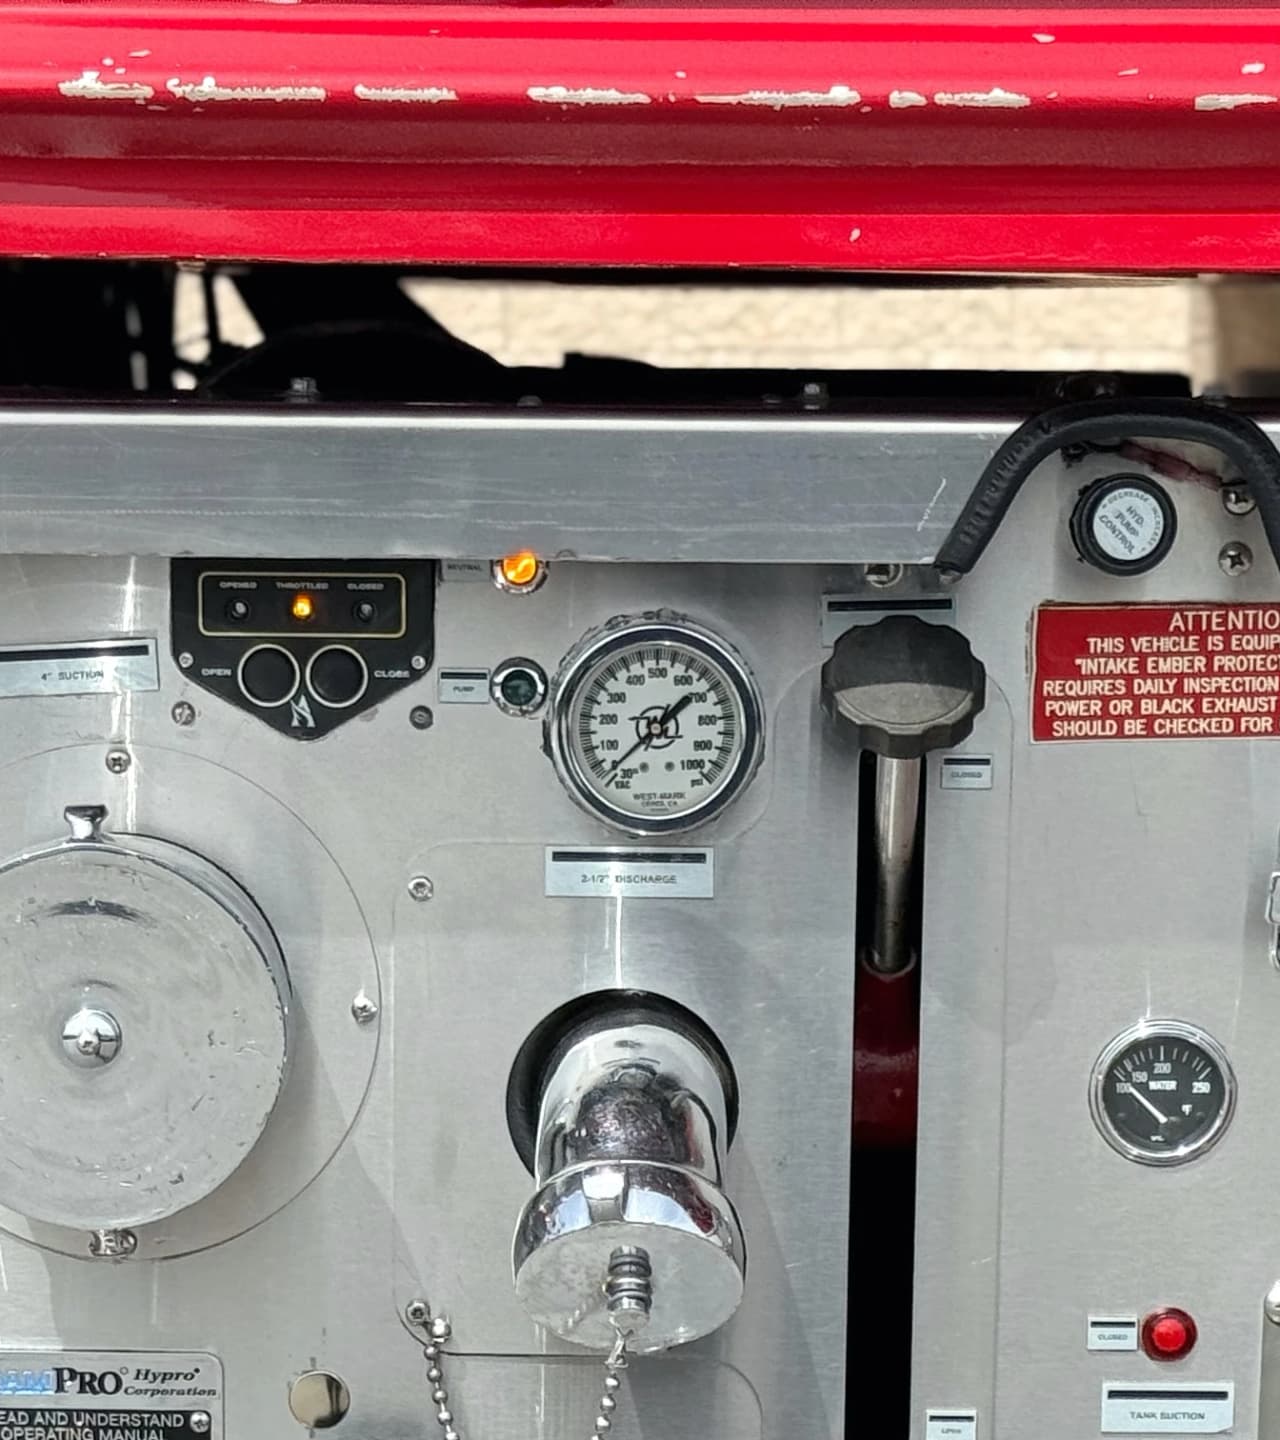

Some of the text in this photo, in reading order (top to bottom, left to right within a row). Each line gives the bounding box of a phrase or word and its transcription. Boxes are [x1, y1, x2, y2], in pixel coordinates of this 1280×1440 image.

[1115, 511, 1140, 537] PUMP
[1099, 514, 1135, 555] CONTROL
[447, 563, 483, 572] NEUTRAL
[275, 581, 329, 590] THROTTLED
[1086, 637, 1125, 654] THIS
[1131, 635, 1200, 653] VEHICLE
[1207, 635, 1224, 652] IS
[1074, 657, 1140, 676] "INTAKE
[1146, 656, 1207, 674] EMBER
[57, 671, 105, 681] SUCTION
[201, 668, 233, 677] OPEN
[374, 669, 410, 679] CLOSE
[647, 667, 668, 679] 500
[625, 674, 646, 686] 400
[673, 674, 694, 686] 600
[1043, 679, 1126, 697] REQUIRES
[1133, 678, 1177, 695] DAILY
[1183, 676, 1280, 694] INSPECTION
[606, 692, 627, 703] 300
[689, 692, 708, 703] 700
[1045, 700, 1102, 717] POWER
[1109, 699, 1134, 716] OR
[1141, 698, 1195, 715] BLACK
[1202, 695, 1278, 714] EXHAUST
[598, 714, 618, 725] 200
[697, 715, 718, 726] 800
[1052, 719, 1118, 737] SHOULD
[1124, 719, 1147, 735] BE
[1153, 716, 1235, 735] CHECKED
[1240, 716, 1273, 733] FOR
[599, 739, 619, 751] 100
[693, 740, 713, 751] 900
[679, 759, 706, 770] 1000
[615, 874, 678, 885] DISCHARGE
[1153, 1062, 1172, 1074] 200
[1131, 1071, 1148, 1083] 150
[1148, 1080, 1178, 1091] WATER
[1191, 1081, 1211, 1094] 250
[134, 1368, 196, 1384] Hypro
[123, 1386, 217, 1397] Corporation
[33, 1411, 69, 1426] AND
[73, 1411, 185, 1428] UNDERSTAND
[1129, 1411, 1206, 1421] TANK SUCTION
